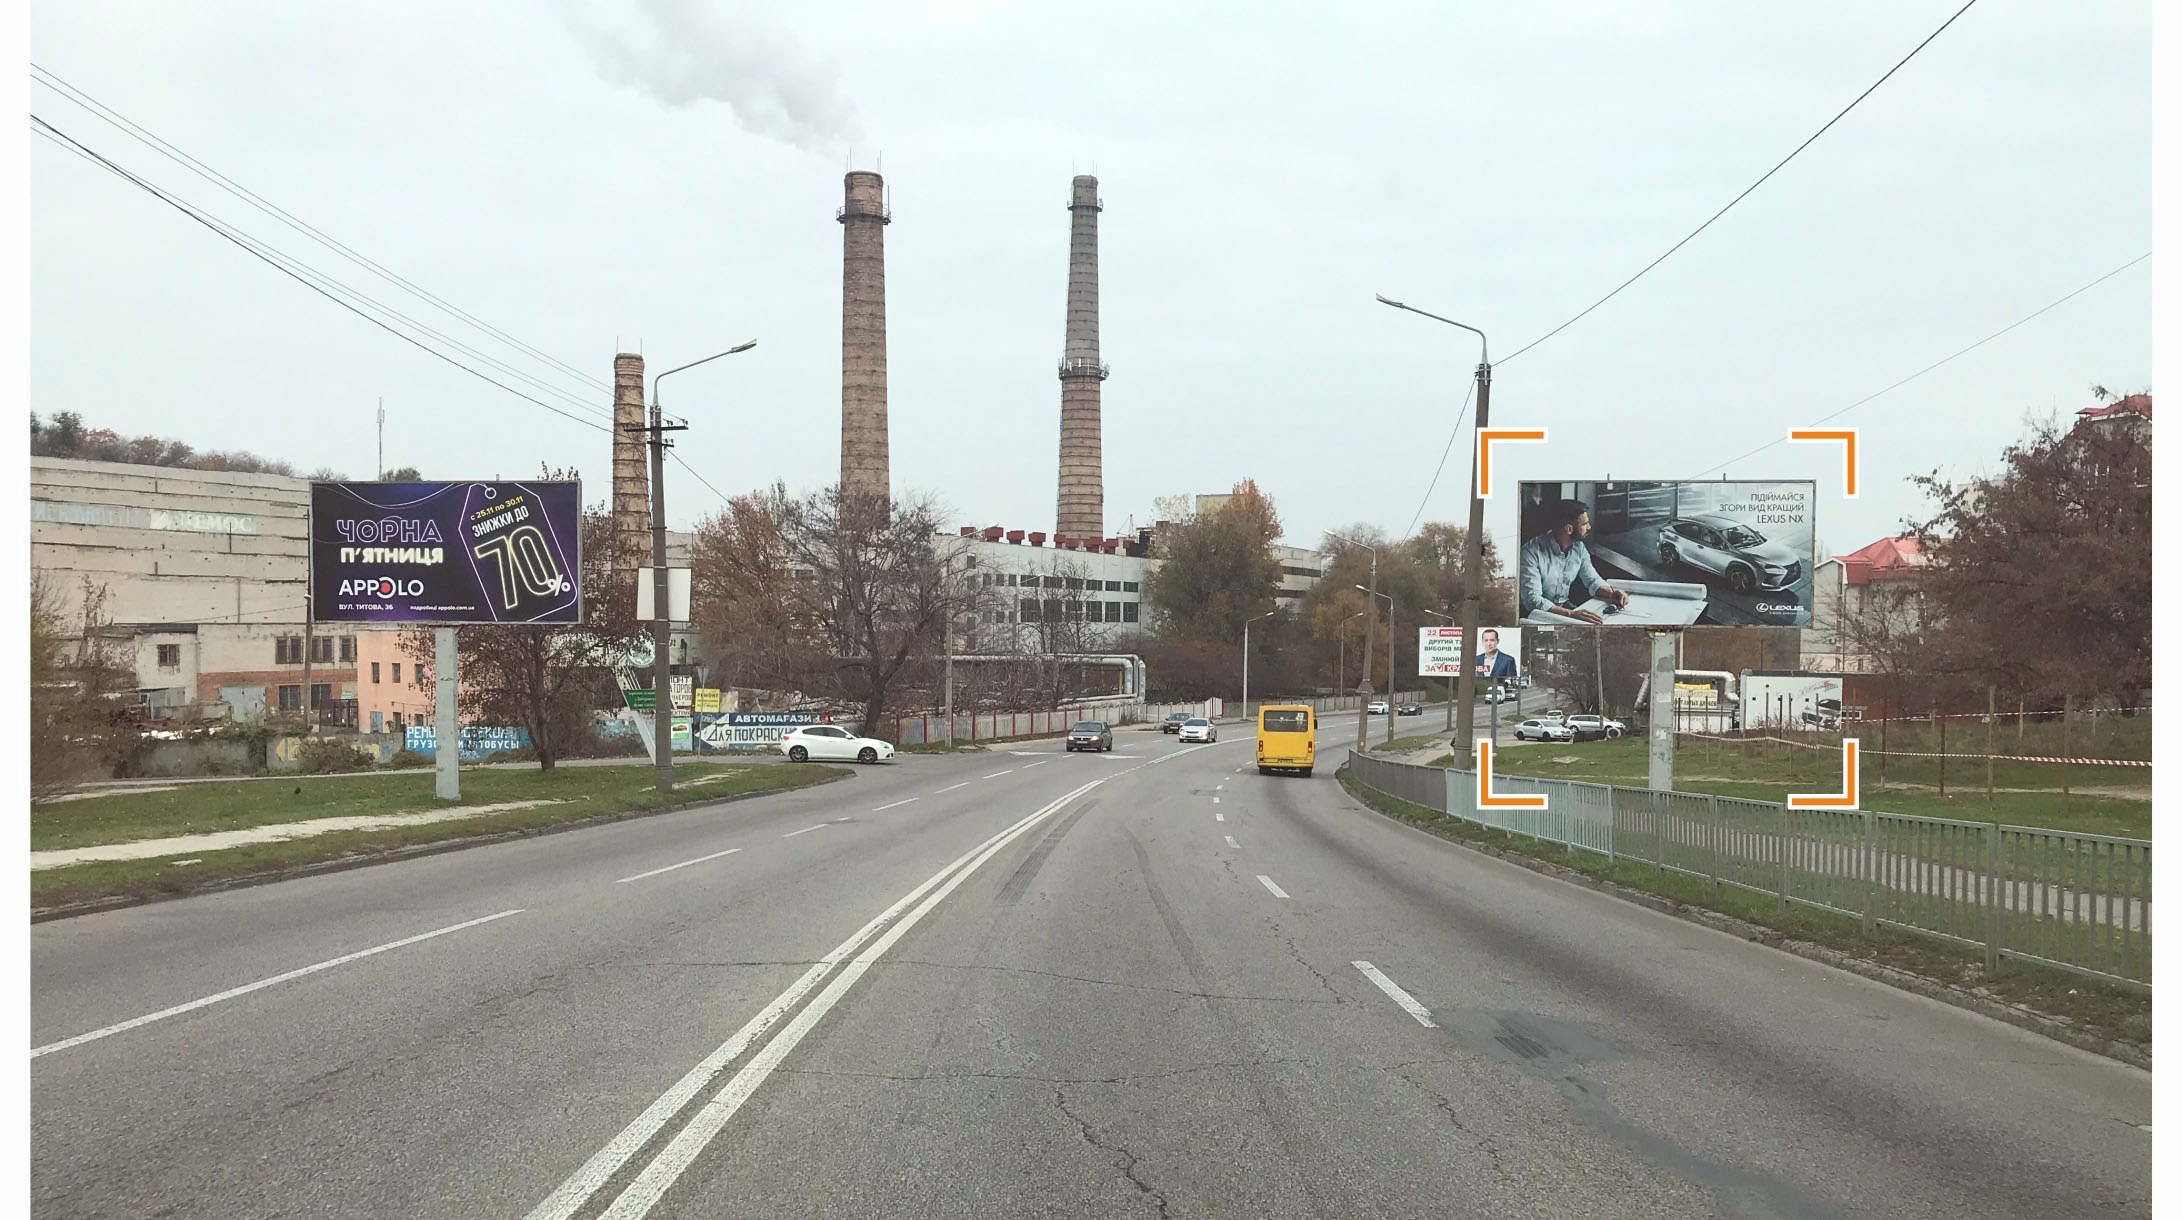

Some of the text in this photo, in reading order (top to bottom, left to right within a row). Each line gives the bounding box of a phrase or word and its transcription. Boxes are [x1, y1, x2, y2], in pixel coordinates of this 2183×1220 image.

[1751, 492, 1804, 502] ПІДІЙМАЙСЯ
[476, 507, 494, 518] 25.11
[495, 503, 505, 511] по
[505, 495, 524, 507] 30.11
[1749, 504, 1765, 512] ВИД
[1768, 503, 1804, 512] КРАЩИЙ
[472, 505, 529, 537] ЗНИЖКИ ДО
[1757, 514, 1804, 524] LEXUS NX
[336, 519, 443, 543] ЧОРНА
[338, 576, 424, 599] APPOLO
[1425, 665, 1436, 673] ЗА
